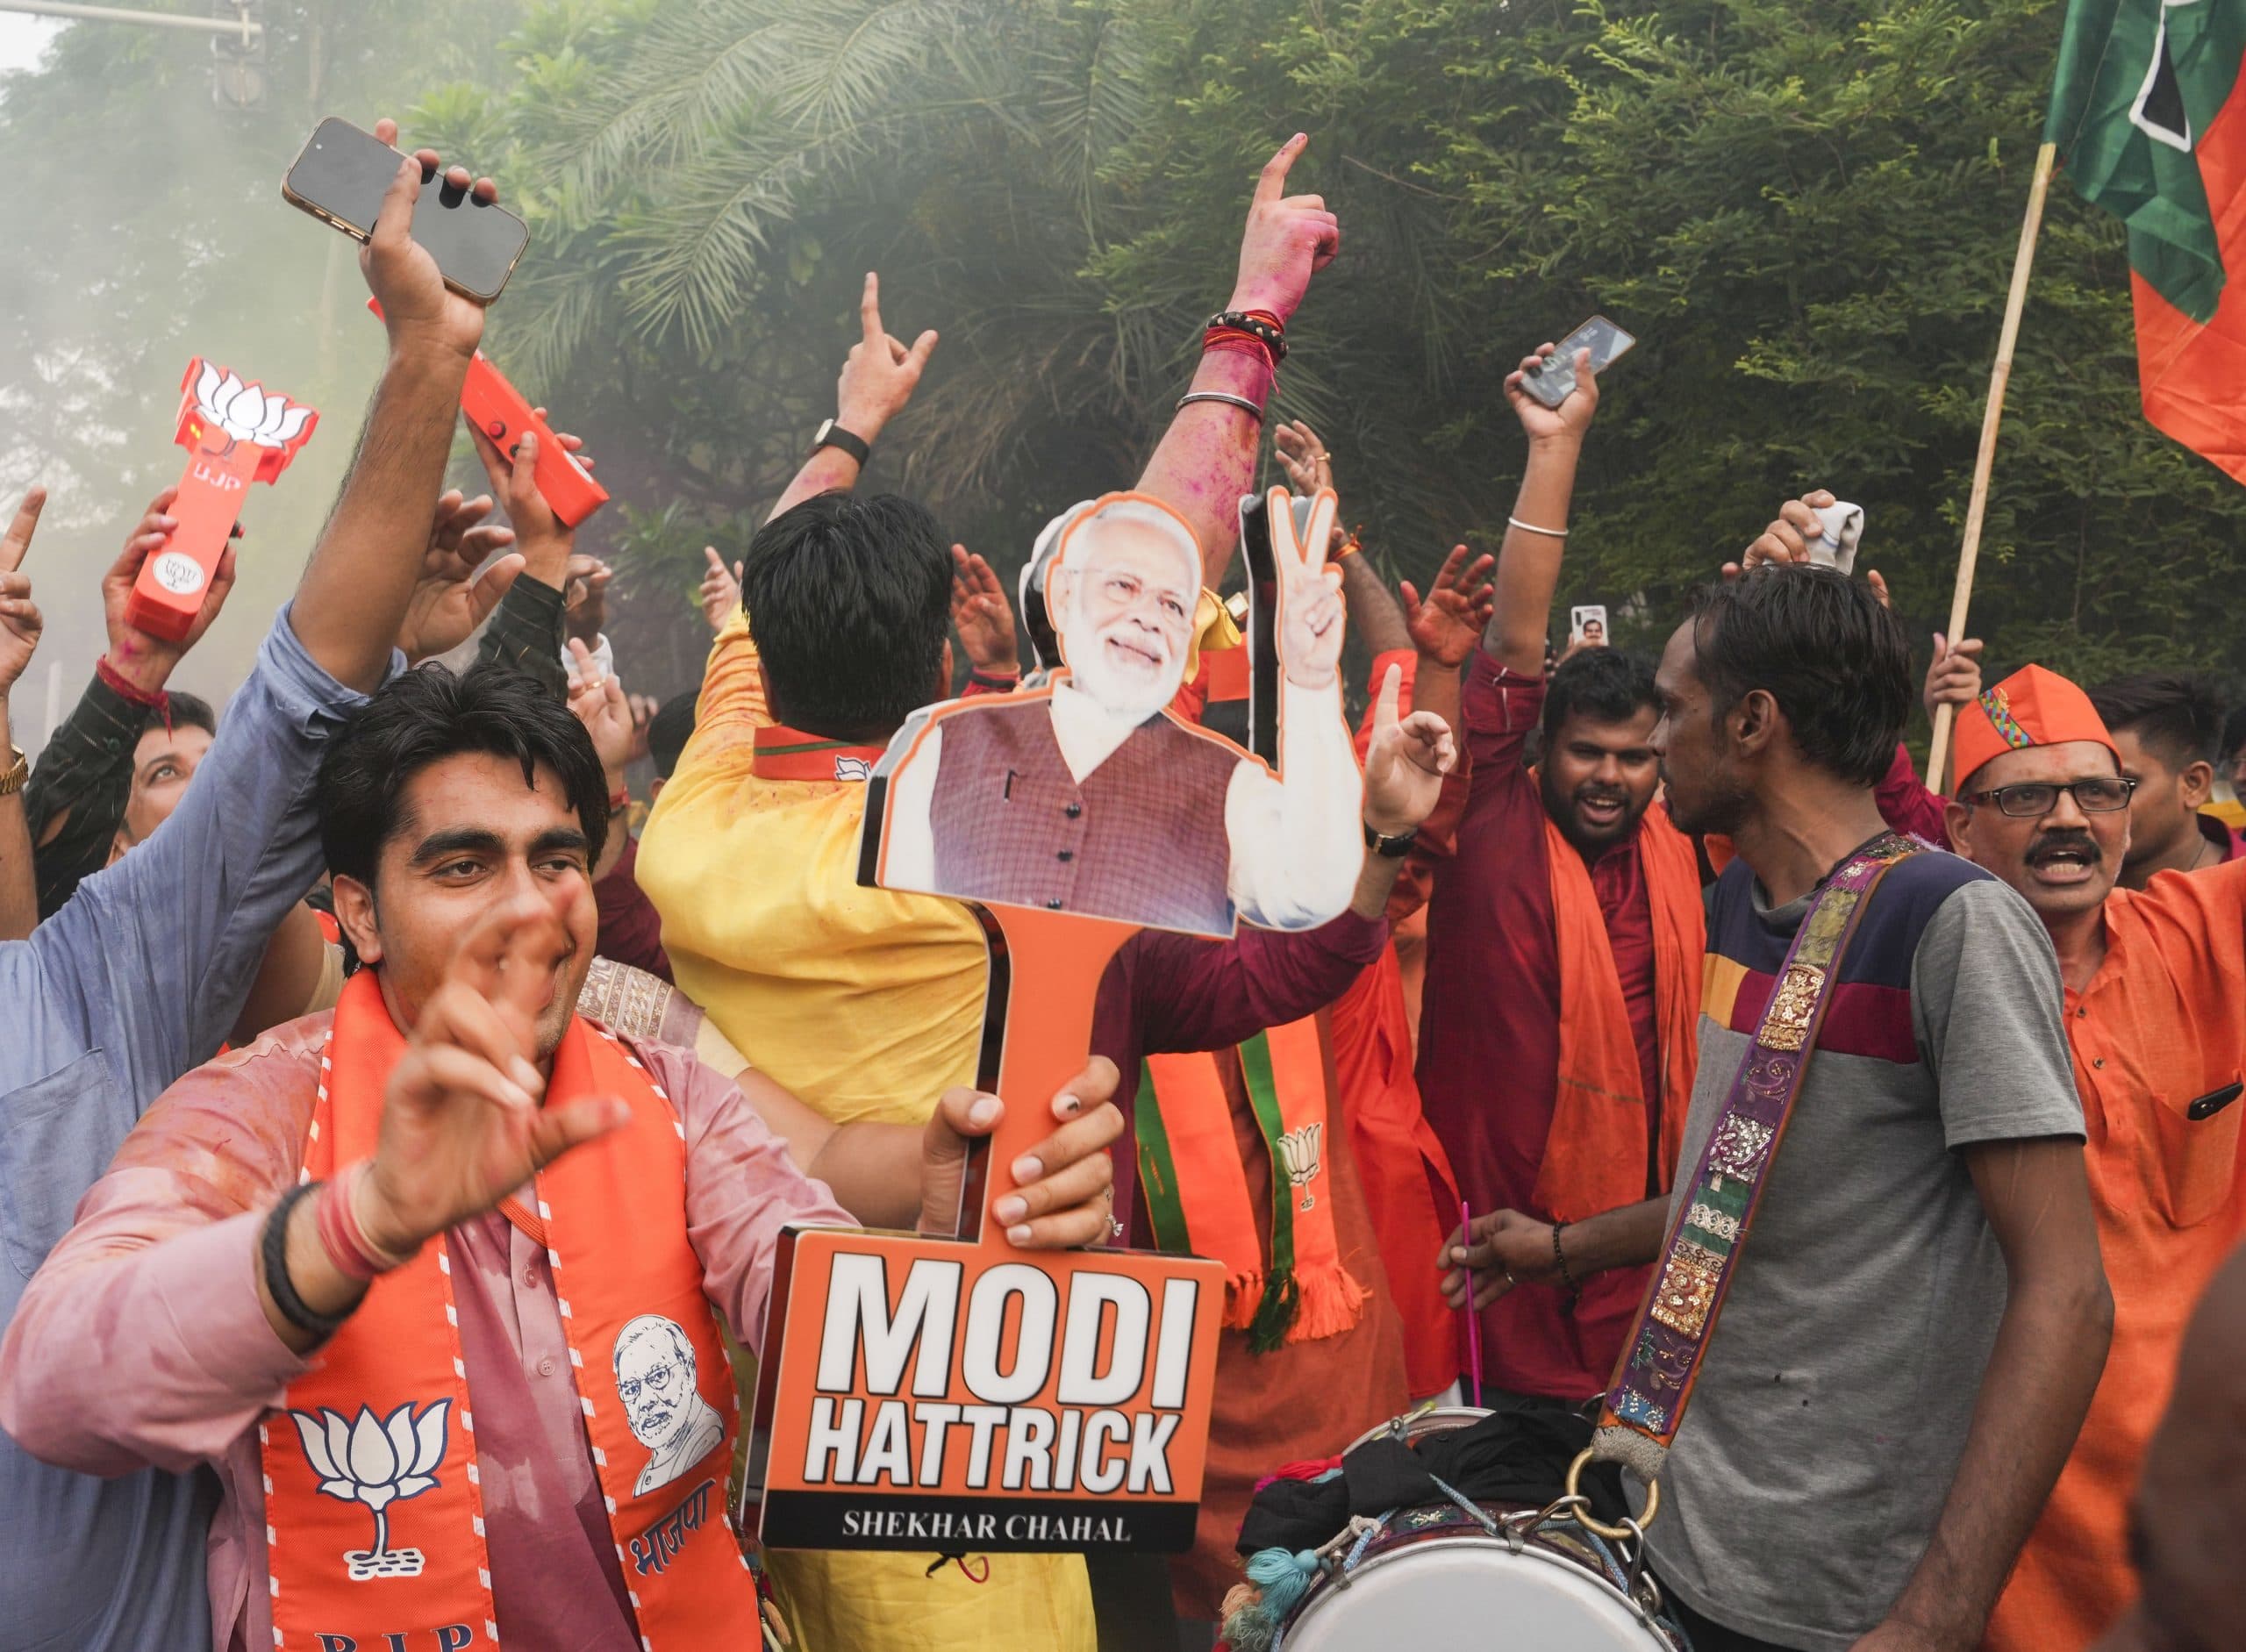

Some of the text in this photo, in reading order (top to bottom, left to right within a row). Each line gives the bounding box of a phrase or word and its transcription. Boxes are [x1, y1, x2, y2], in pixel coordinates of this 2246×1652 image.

[815, 1252, 1199, 1409] MODI
[803, 1397, 1181, 1494] HATTRICK
[630, 1477, 716, 1577] भाजपा
[842, 1510, 1132, 1542] SHEKHAR CHAHAL
